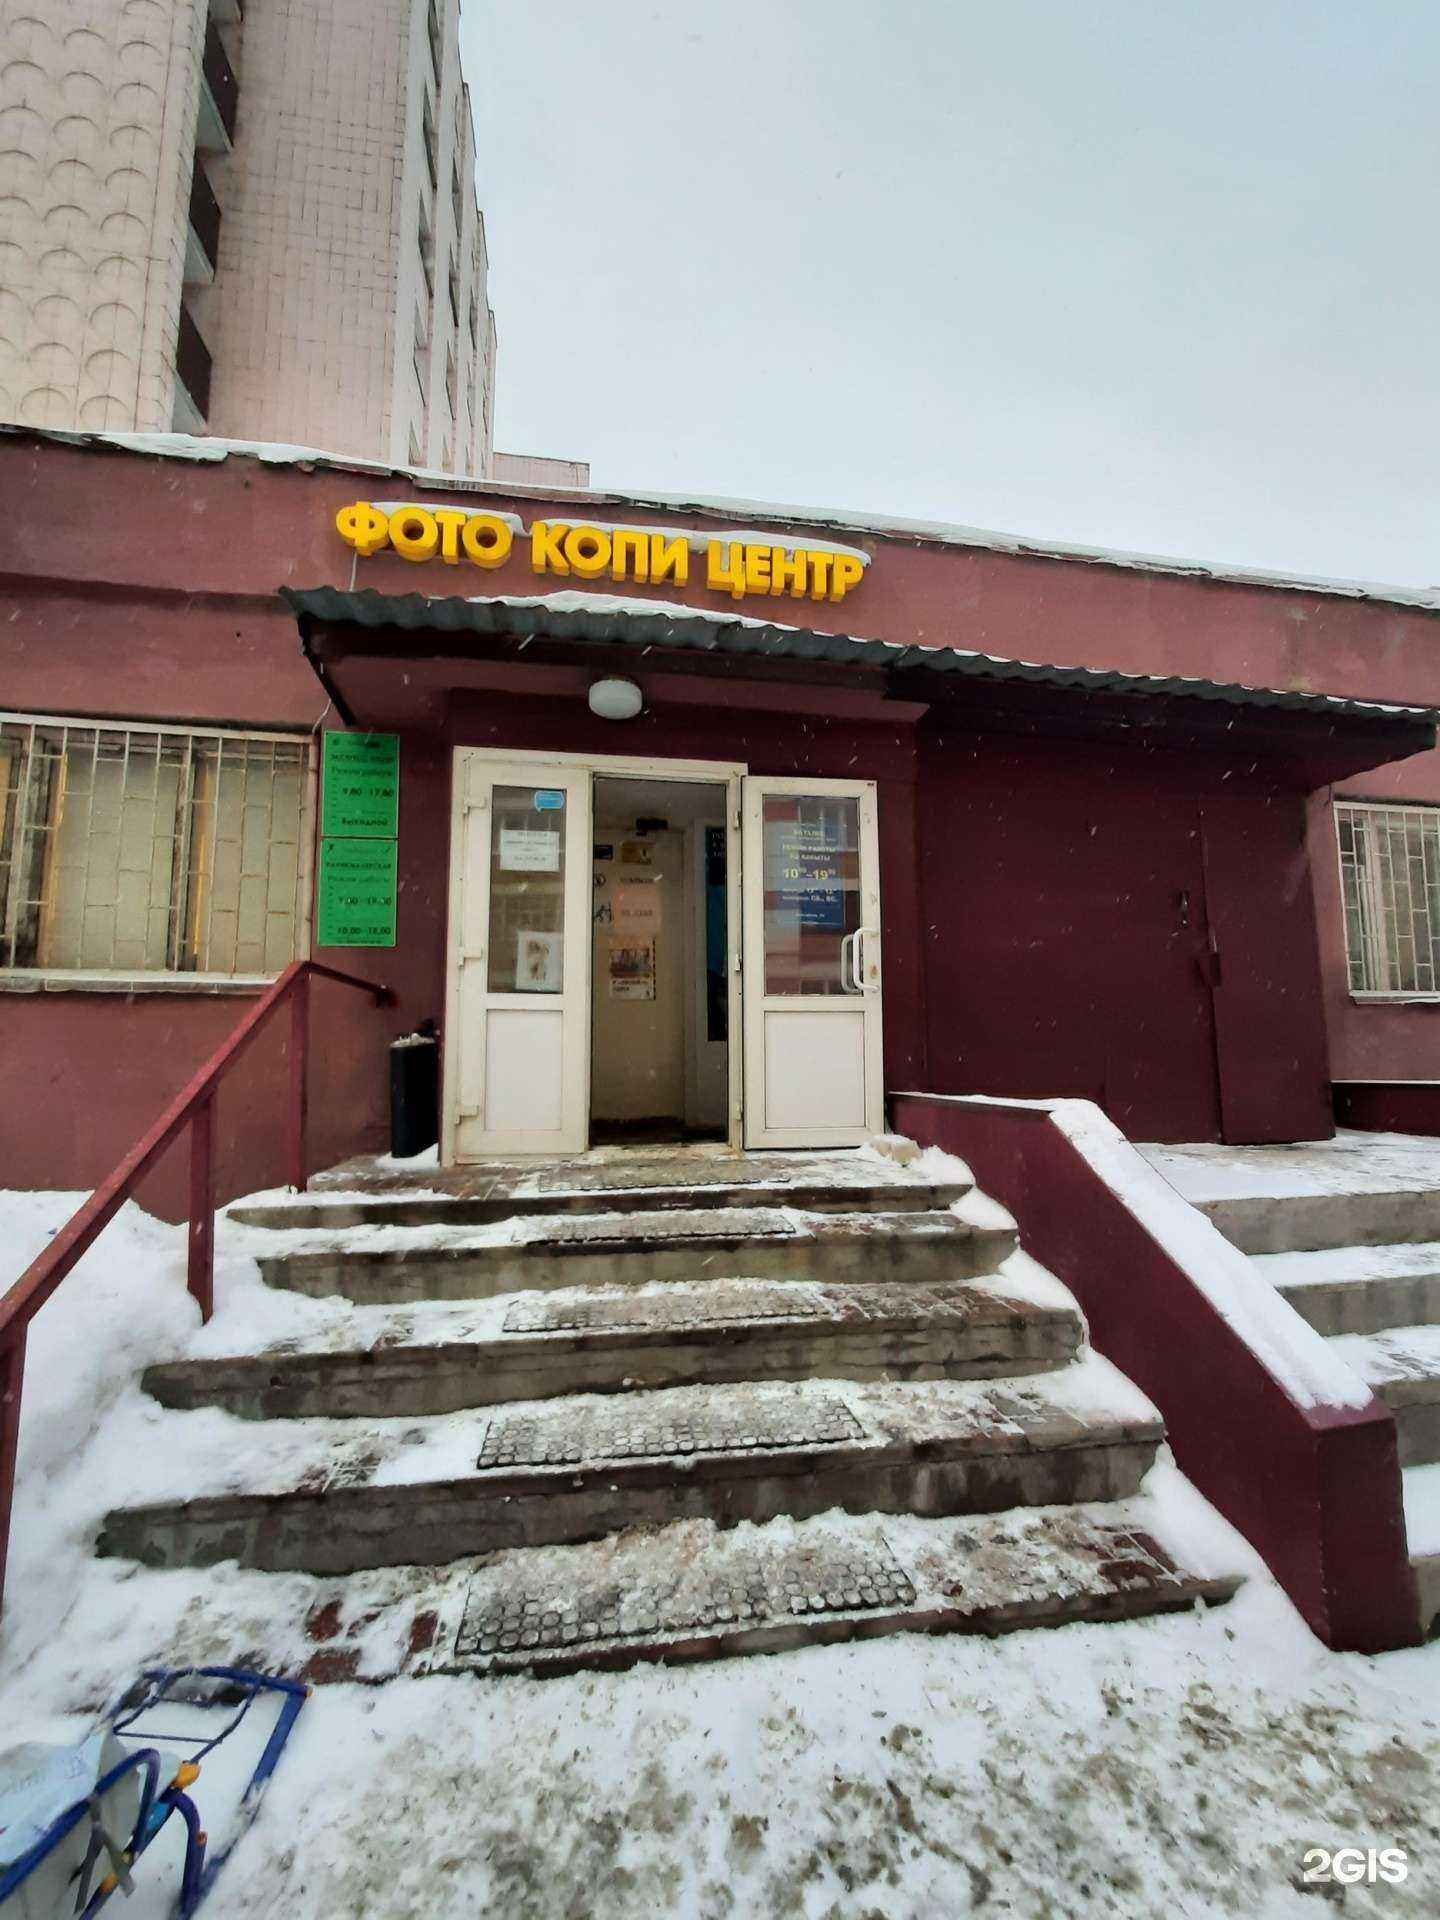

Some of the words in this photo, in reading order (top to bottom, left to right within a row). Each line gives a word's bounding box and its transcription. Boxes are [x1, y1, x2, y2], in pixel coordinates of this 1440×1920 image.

[336, 501, 513, 569] ФОТО
[532, 521, 688, 587] КОПИ
[707, 540, 864, 602] ЦЕНТР
